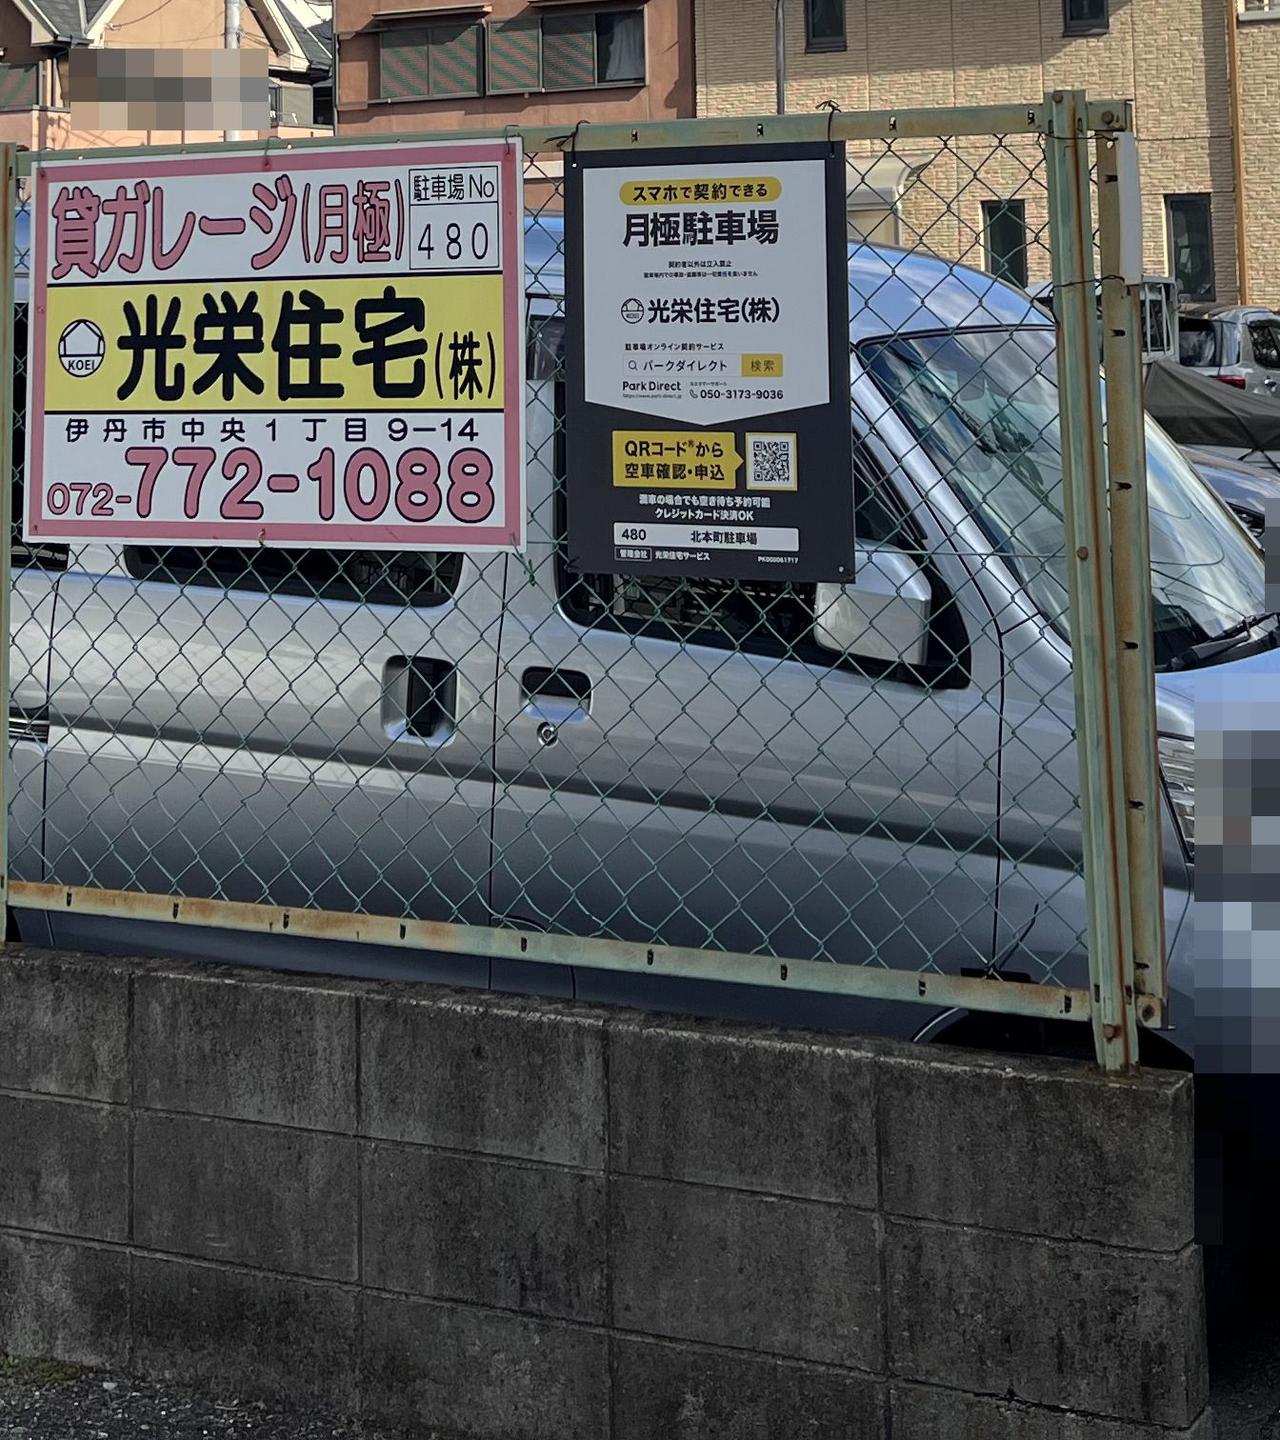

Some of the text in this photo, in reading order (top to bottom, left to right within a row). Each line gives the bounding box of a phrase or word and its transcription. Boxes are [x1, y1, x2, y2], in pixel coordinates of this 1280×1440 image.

[632, 183, 768, 201] スマホで契約できる
[51, 174, 405, 279] 貸ガレージ(月極)
[622, 210, 780, 247] 月極駐車場
[417, 222, 489, 260] 480
[647, 297, 780, 324] 光栄住宅(株)
[116, 286, 495, 402] 光栄住宅(株)
[624, 343, 724, 351] 駐車場オンライン契約サービス
[67, 360, 96, 372] KOEI
[643, 359, 727, 372] パークダイレクト
[750, 359, 775, 372] 検索
[622, 381, 682, 391] Park Direct
[700, 389, 784, 400] 050-3173-9036
[624, 463, 725, 481] 空車確認・申込
[47, 447, 495, 523] 072-772-1088
[654, 507, 755, 521] クレジットカード決済OK
[621, 528, 647, 541] 480
[690, 530, 758, 545] 北本町駐車場
